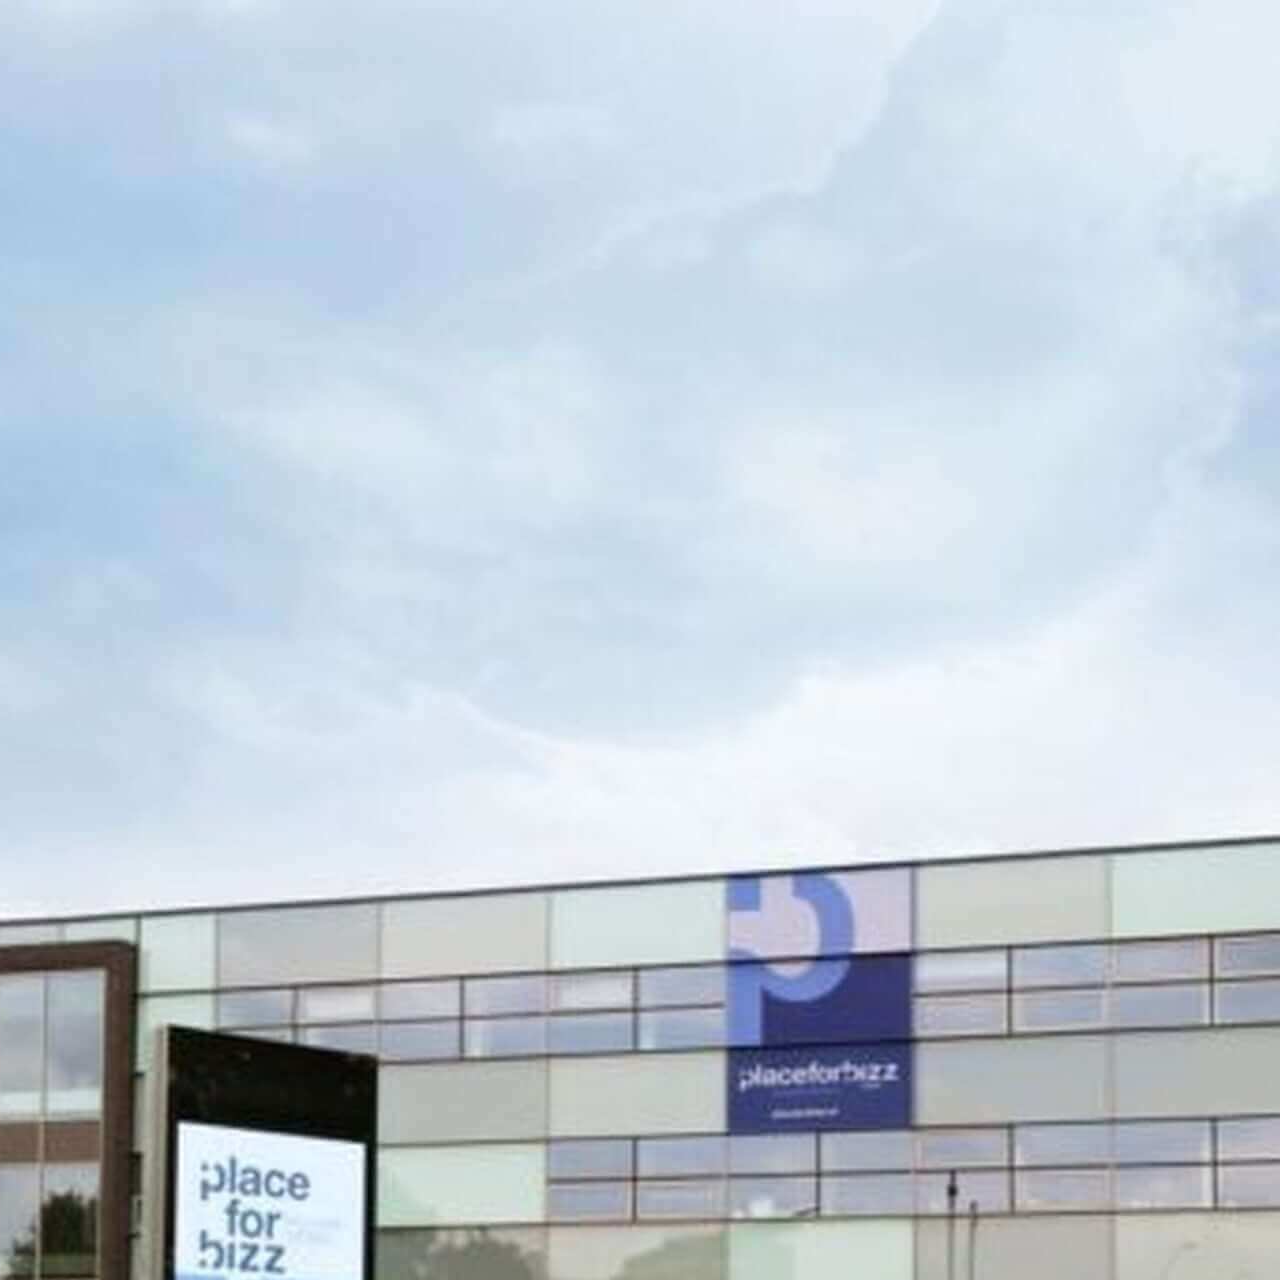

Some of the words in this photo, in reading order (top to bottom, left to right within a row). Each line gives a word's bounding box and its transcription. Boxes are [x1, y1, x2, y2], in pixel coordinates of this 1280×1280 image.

[200, 1155, 311, 1202] place
[224, 1199, 282, 1240] for
[199, 1229, 286, 1275] bizz
